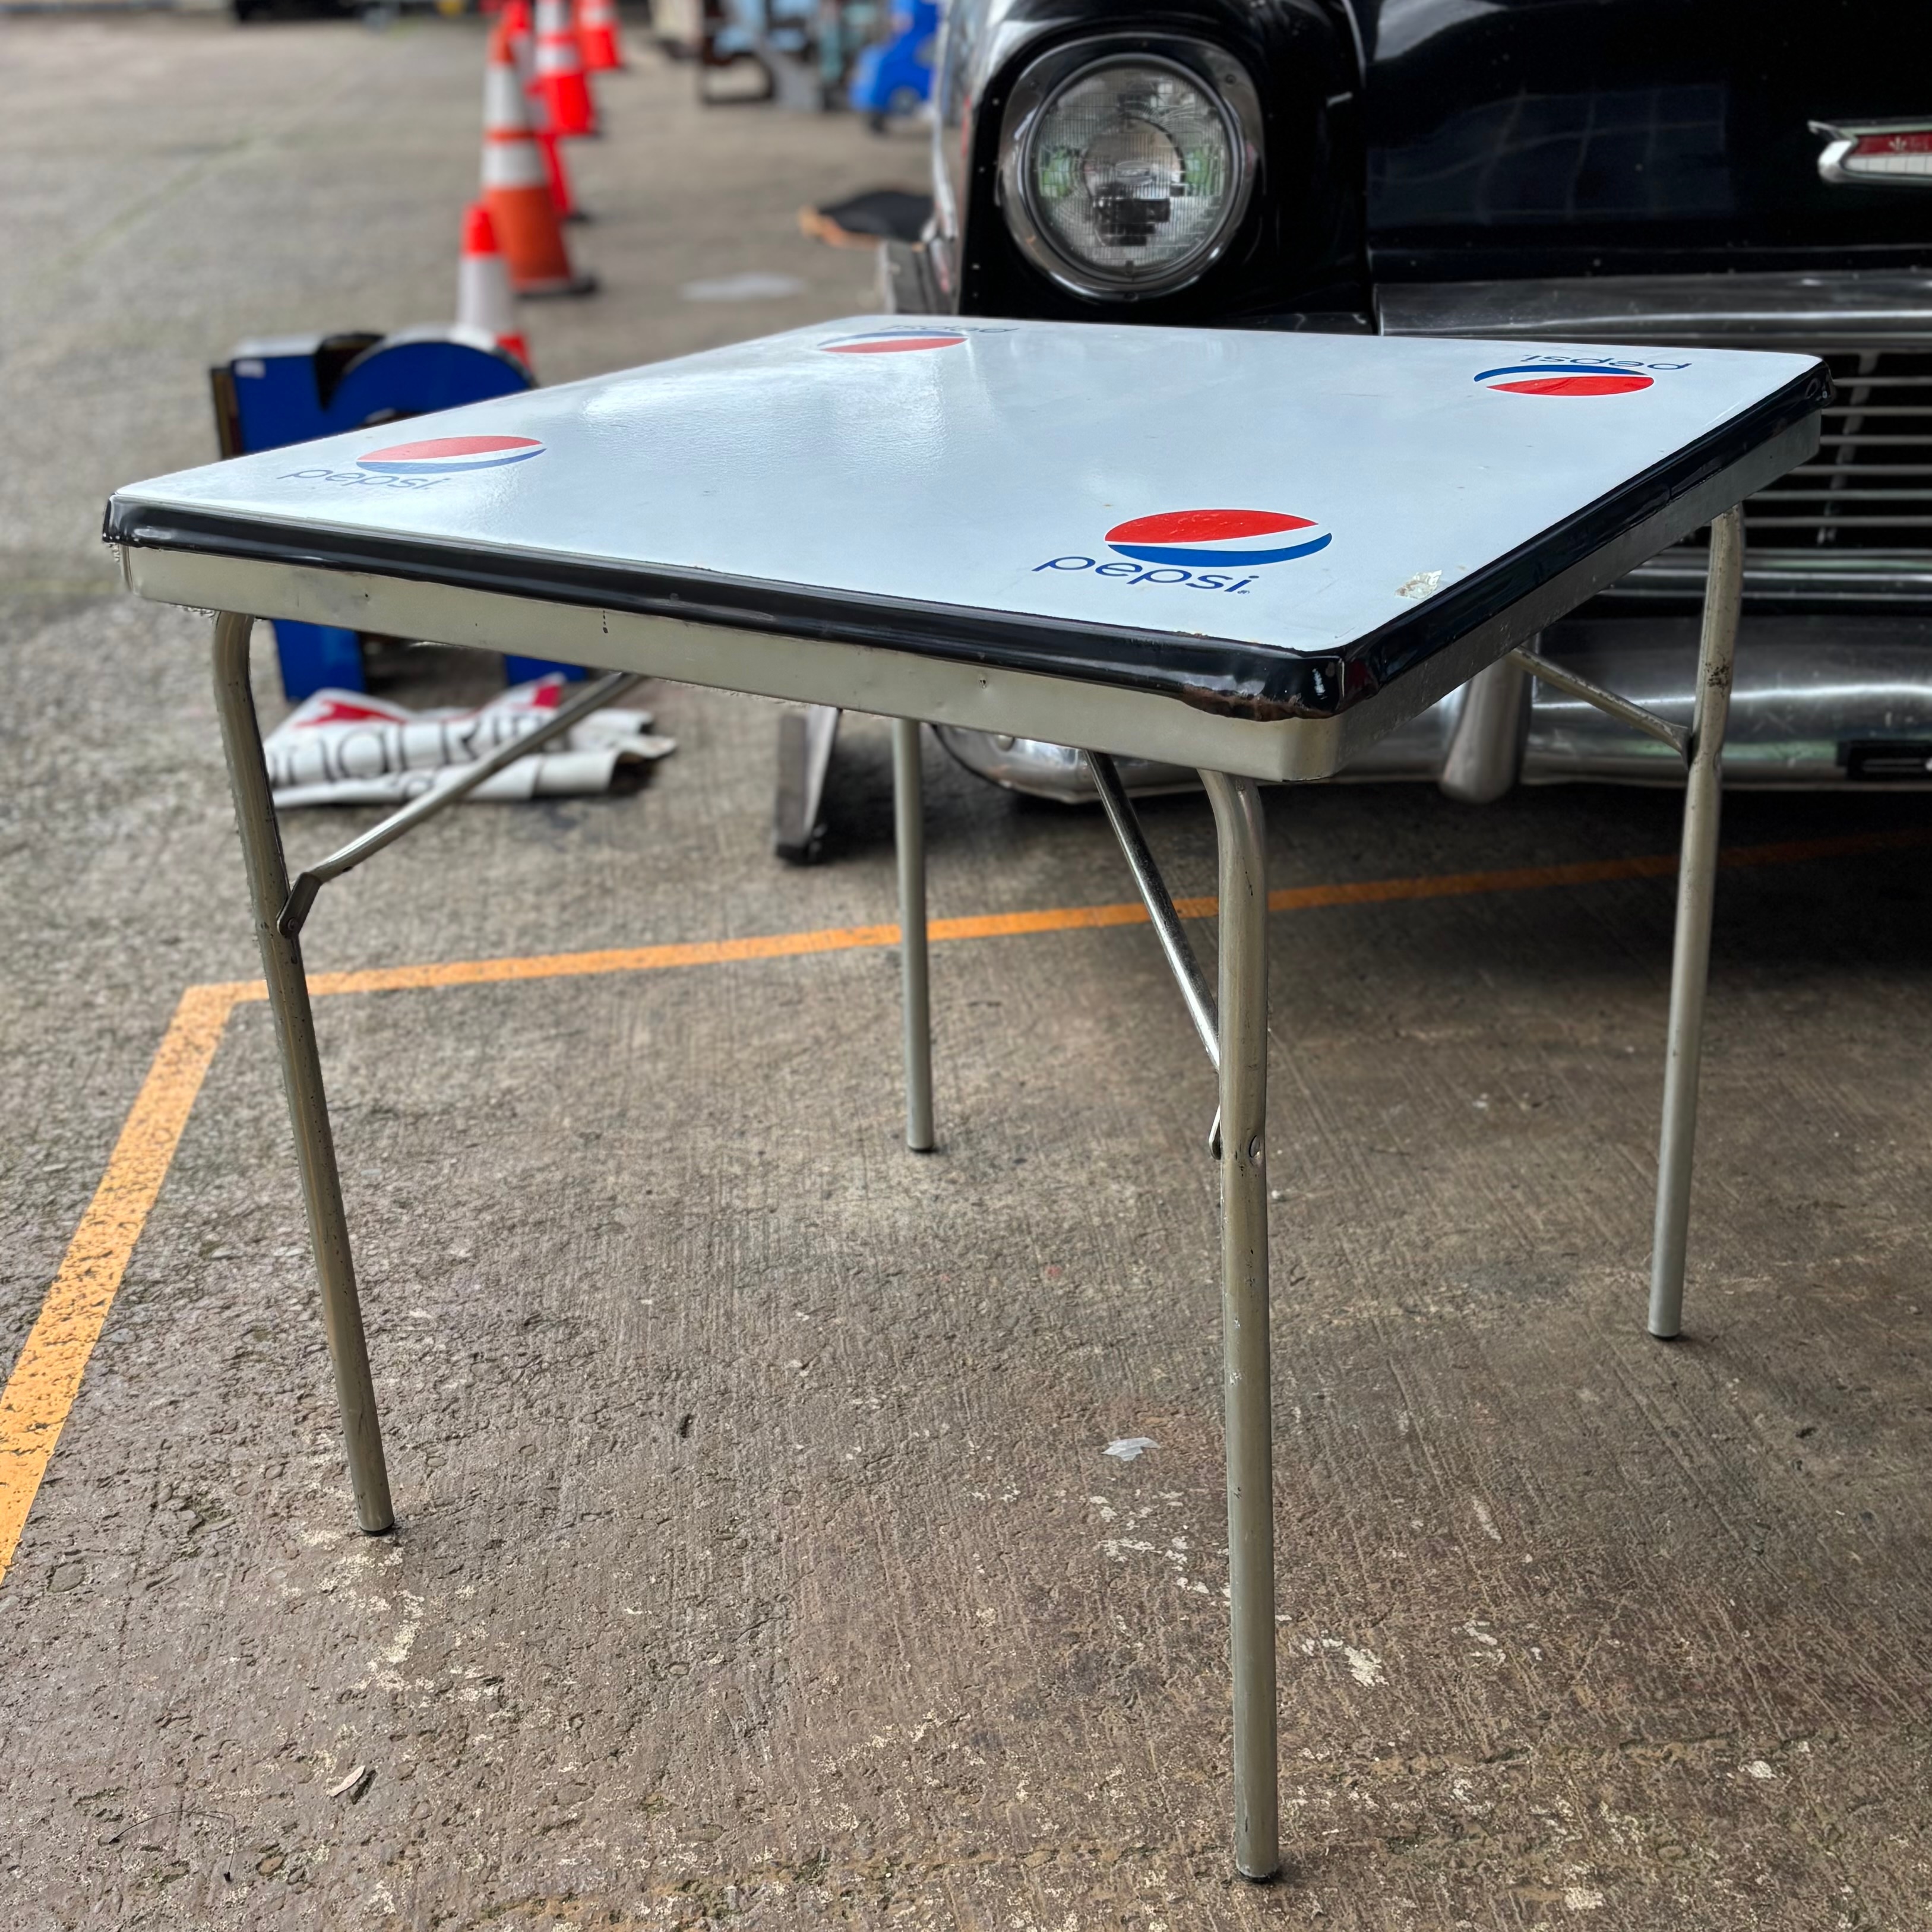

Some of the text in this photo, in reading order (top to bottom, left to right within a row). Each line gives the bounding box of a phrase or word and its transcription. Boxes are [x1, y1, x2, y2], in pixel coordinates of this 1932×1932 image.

[1520, 355, 1693, 371] pepsi
[276, 469, 451, 490] pepsi
[1031, 556, 1260, 593] pepsi
